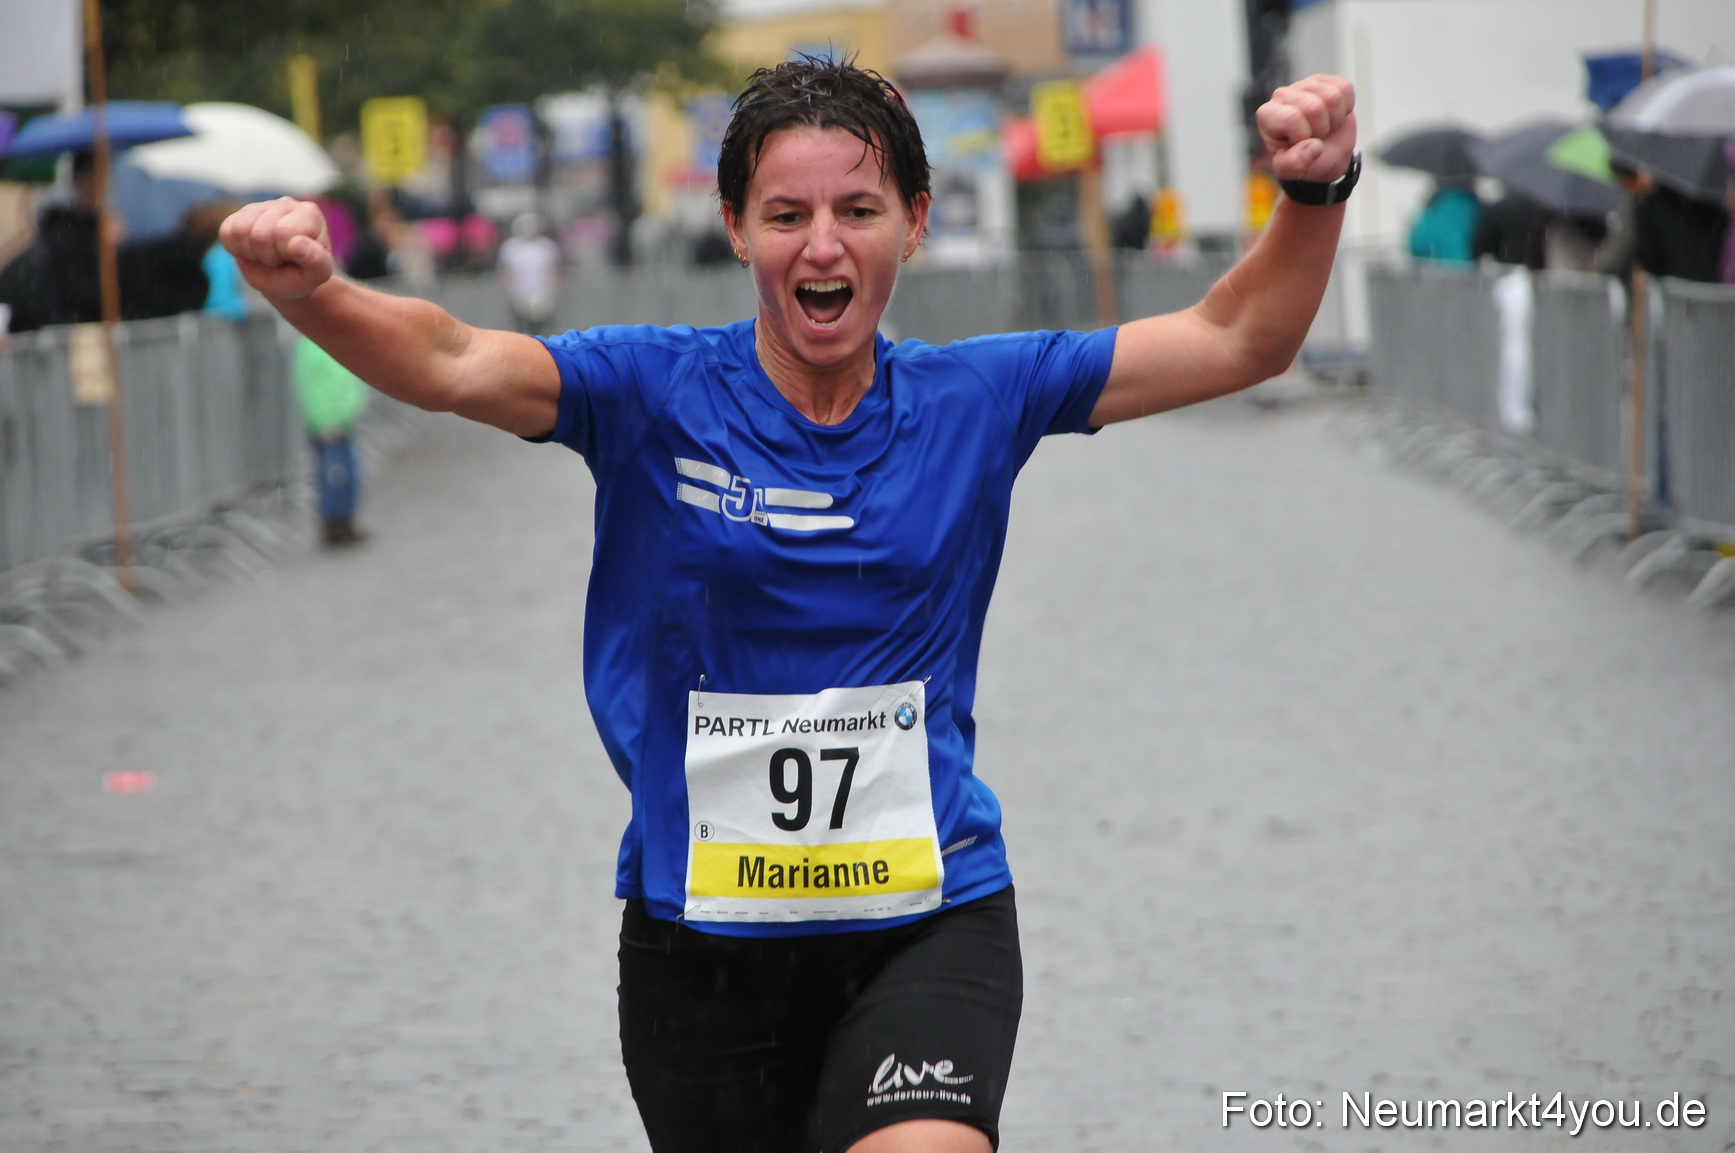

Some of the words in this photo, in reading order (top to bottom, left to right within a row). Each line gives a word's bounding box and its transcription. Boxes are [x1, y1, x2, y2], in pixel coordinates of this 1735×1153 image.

[693, 715, 775, 737] PARTL
[781, 710, 886, 735] Neumarkt
[768, 746, 860, 832] 97
[700, 824, 709, 839] B
[737, 855, 890, 889] Marianne
